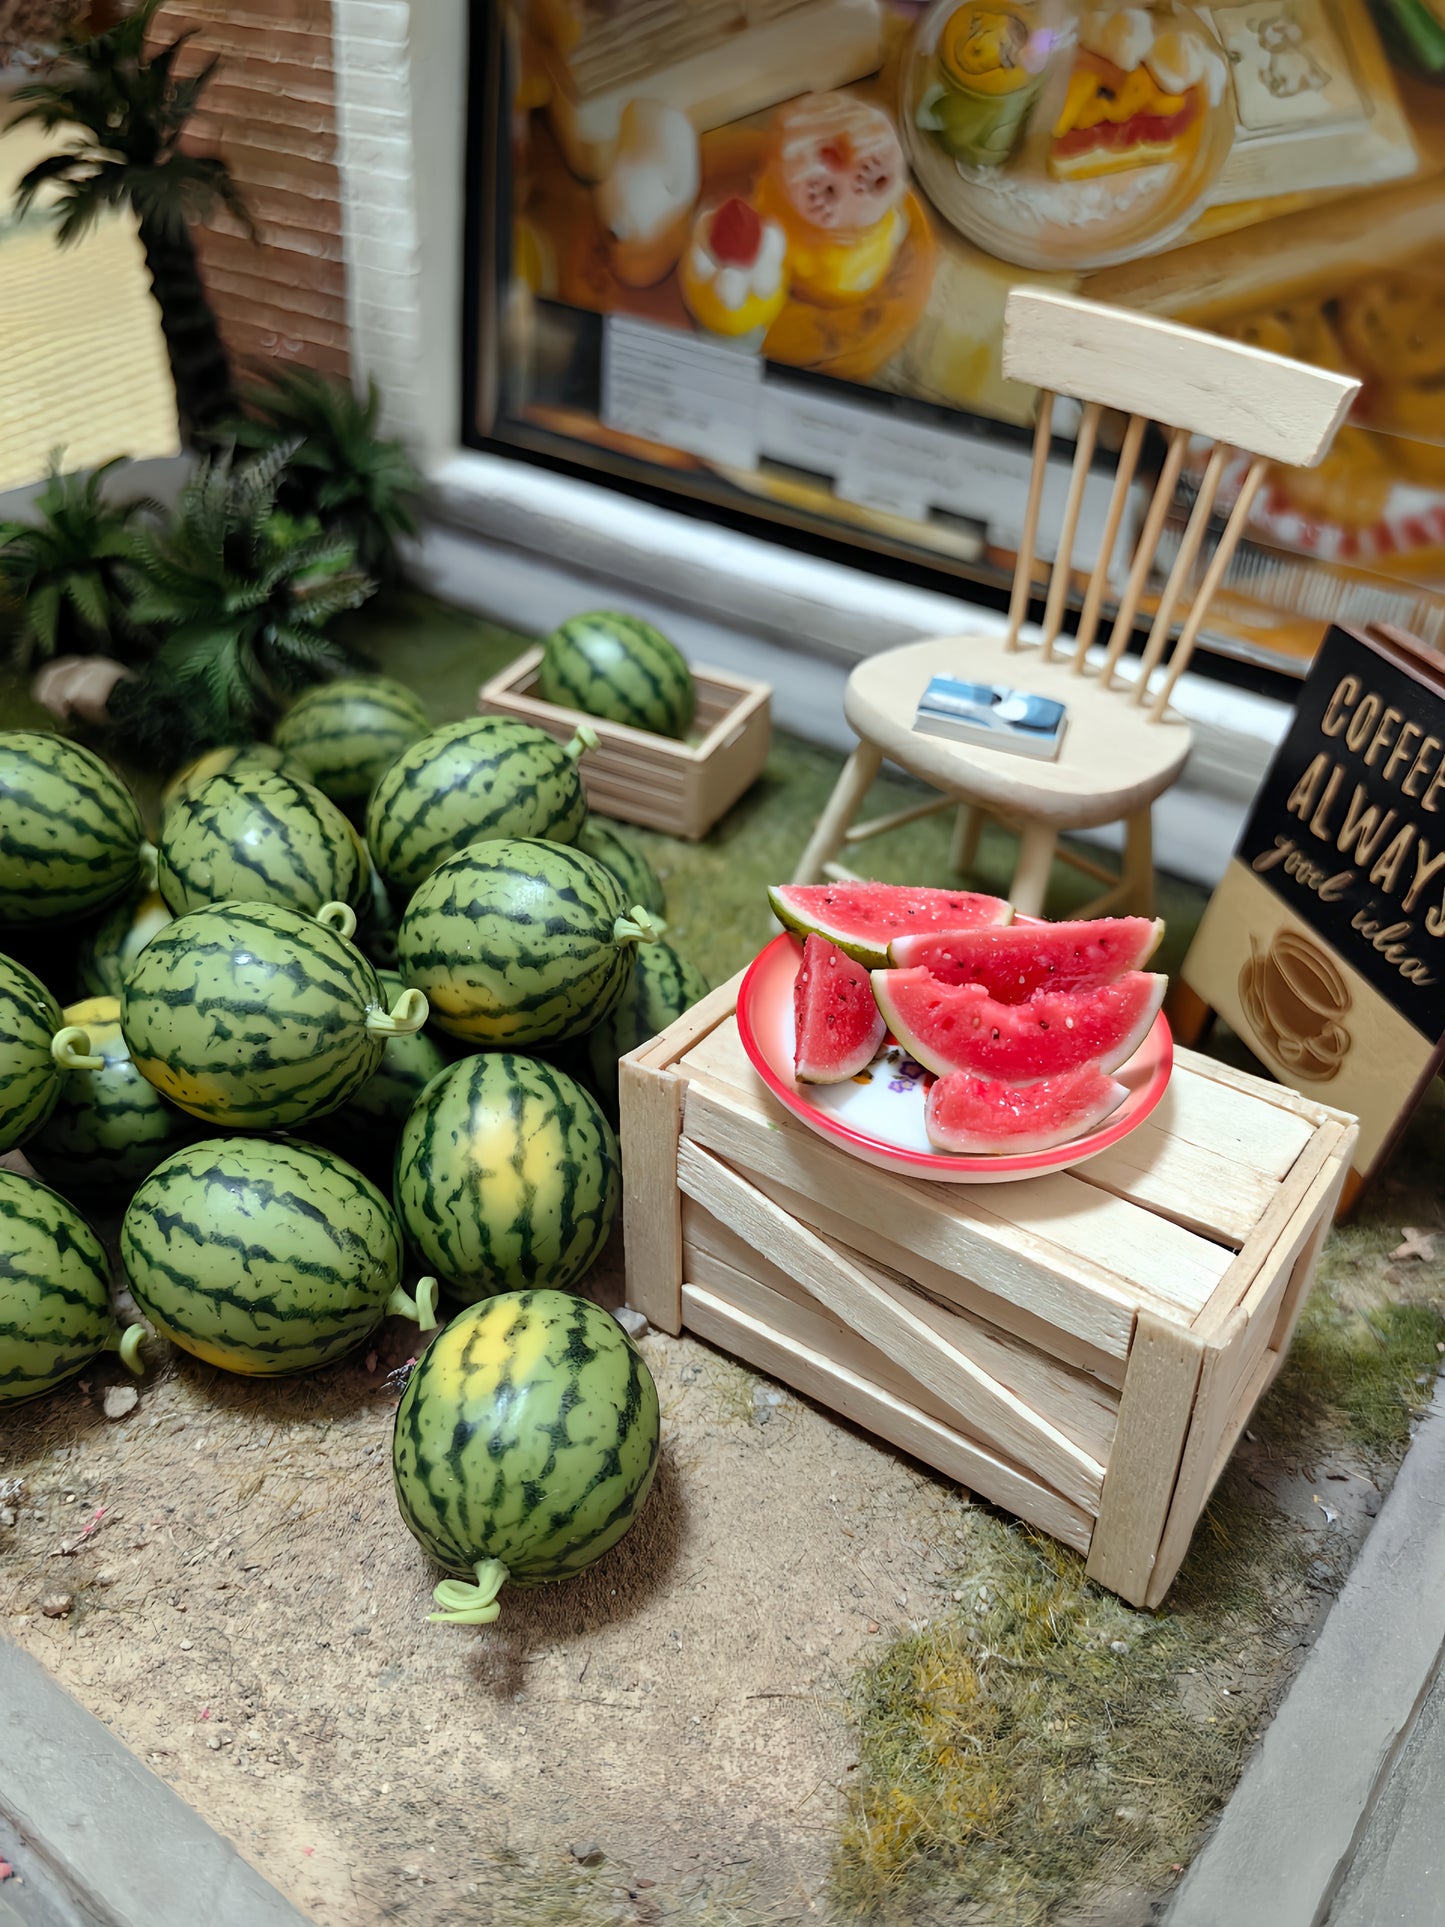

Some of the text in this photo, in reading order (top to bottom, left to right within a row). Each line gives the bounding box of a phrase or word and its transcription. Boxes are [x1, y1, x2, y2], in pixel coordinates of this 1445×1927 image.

[1321, 674, 1445, 812] COFFEE
[1252, 834, 1438, 986] good idea
